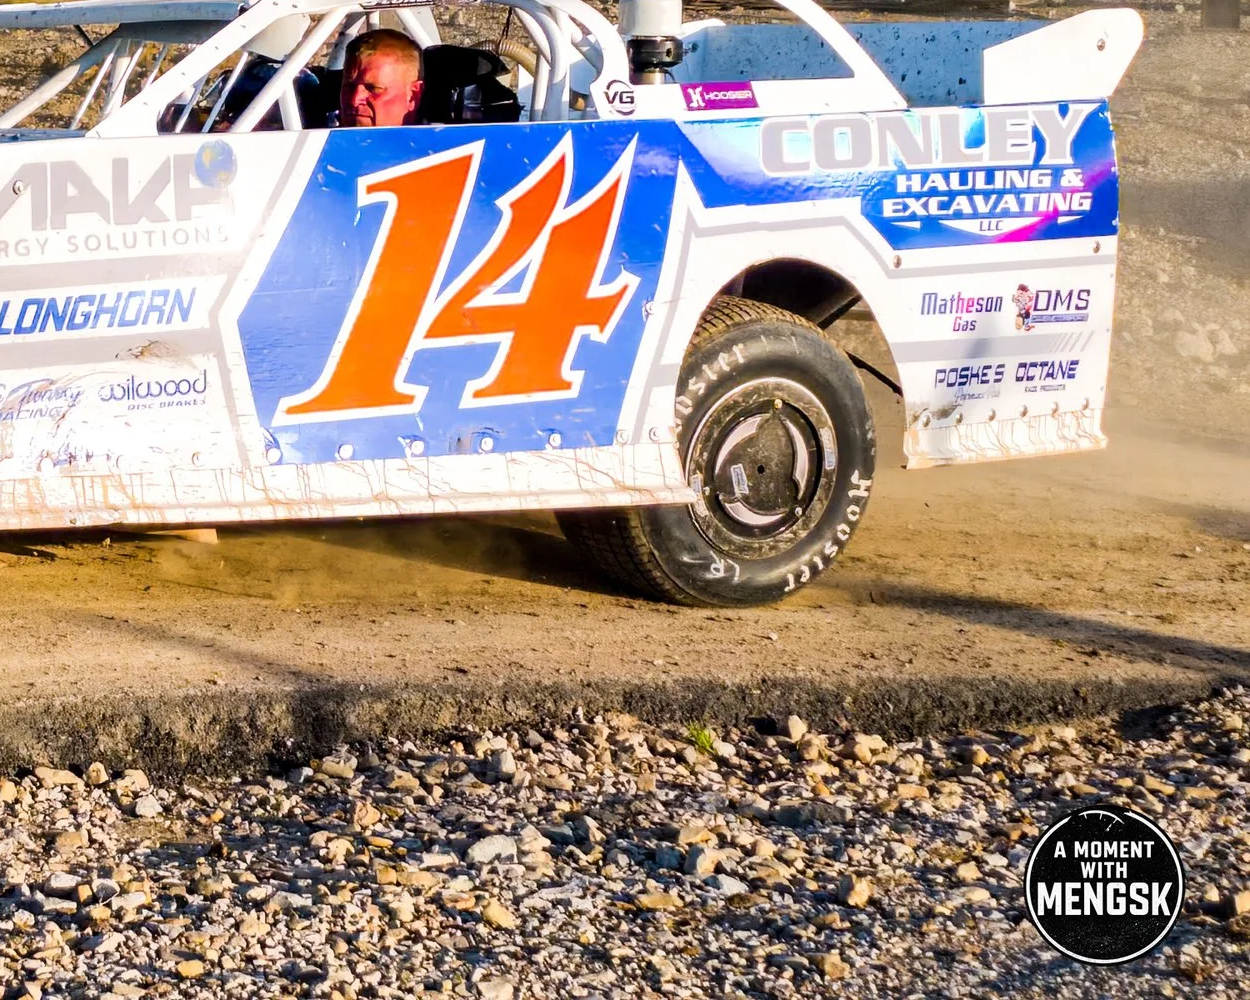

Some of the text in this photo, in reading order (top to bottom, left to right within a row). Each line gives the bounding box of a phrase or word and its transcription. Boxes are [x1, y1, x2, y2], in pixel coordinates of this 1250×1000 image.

[603, 90, 635, 105] VG
[761, 107, 1089, 175] CONLEY
[896, 168, 1085, 193] HAULING &
[882, 191, 1093, 217] EXCAVATING
[978, 219, 1004, 232] LLC
[67, 225, 229, 254] SOLUTIONS
[270, 130, 641, 427] 14
[920, 291, 1004, 316] Matheson
[1032, 288, 1092, 312] DMS
[952, 316, 977, 332] Gas
[1015, 359, 1080, 382] OCTANE
[100, 369, 207, 401] wilwood
[127, 402, 154, 411] DISC
